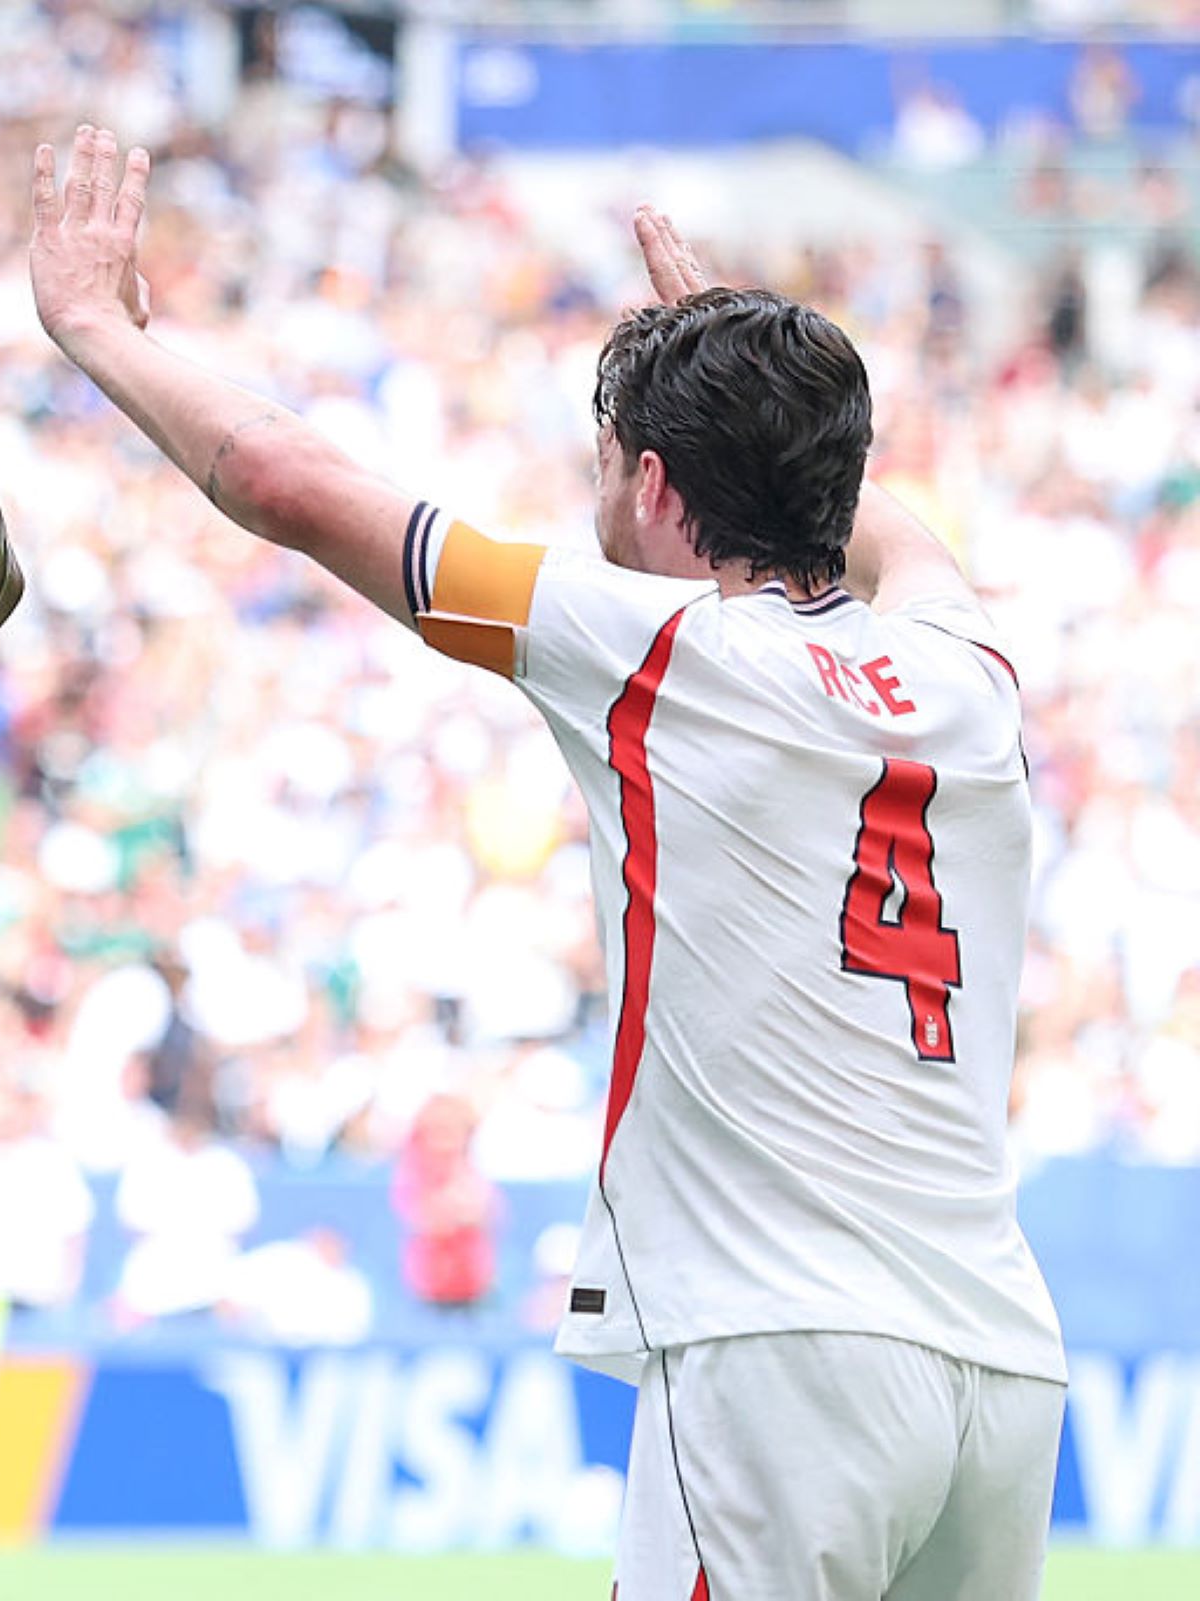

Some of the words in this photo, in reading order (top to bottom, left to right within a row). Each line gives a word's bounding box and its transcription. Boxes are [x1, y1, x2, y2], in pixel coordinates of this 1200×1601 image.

[805, 642, 917, 717] RCE
[840, 757, 962, 1063] 4
[205, 1348, 593, 1549] VISA
